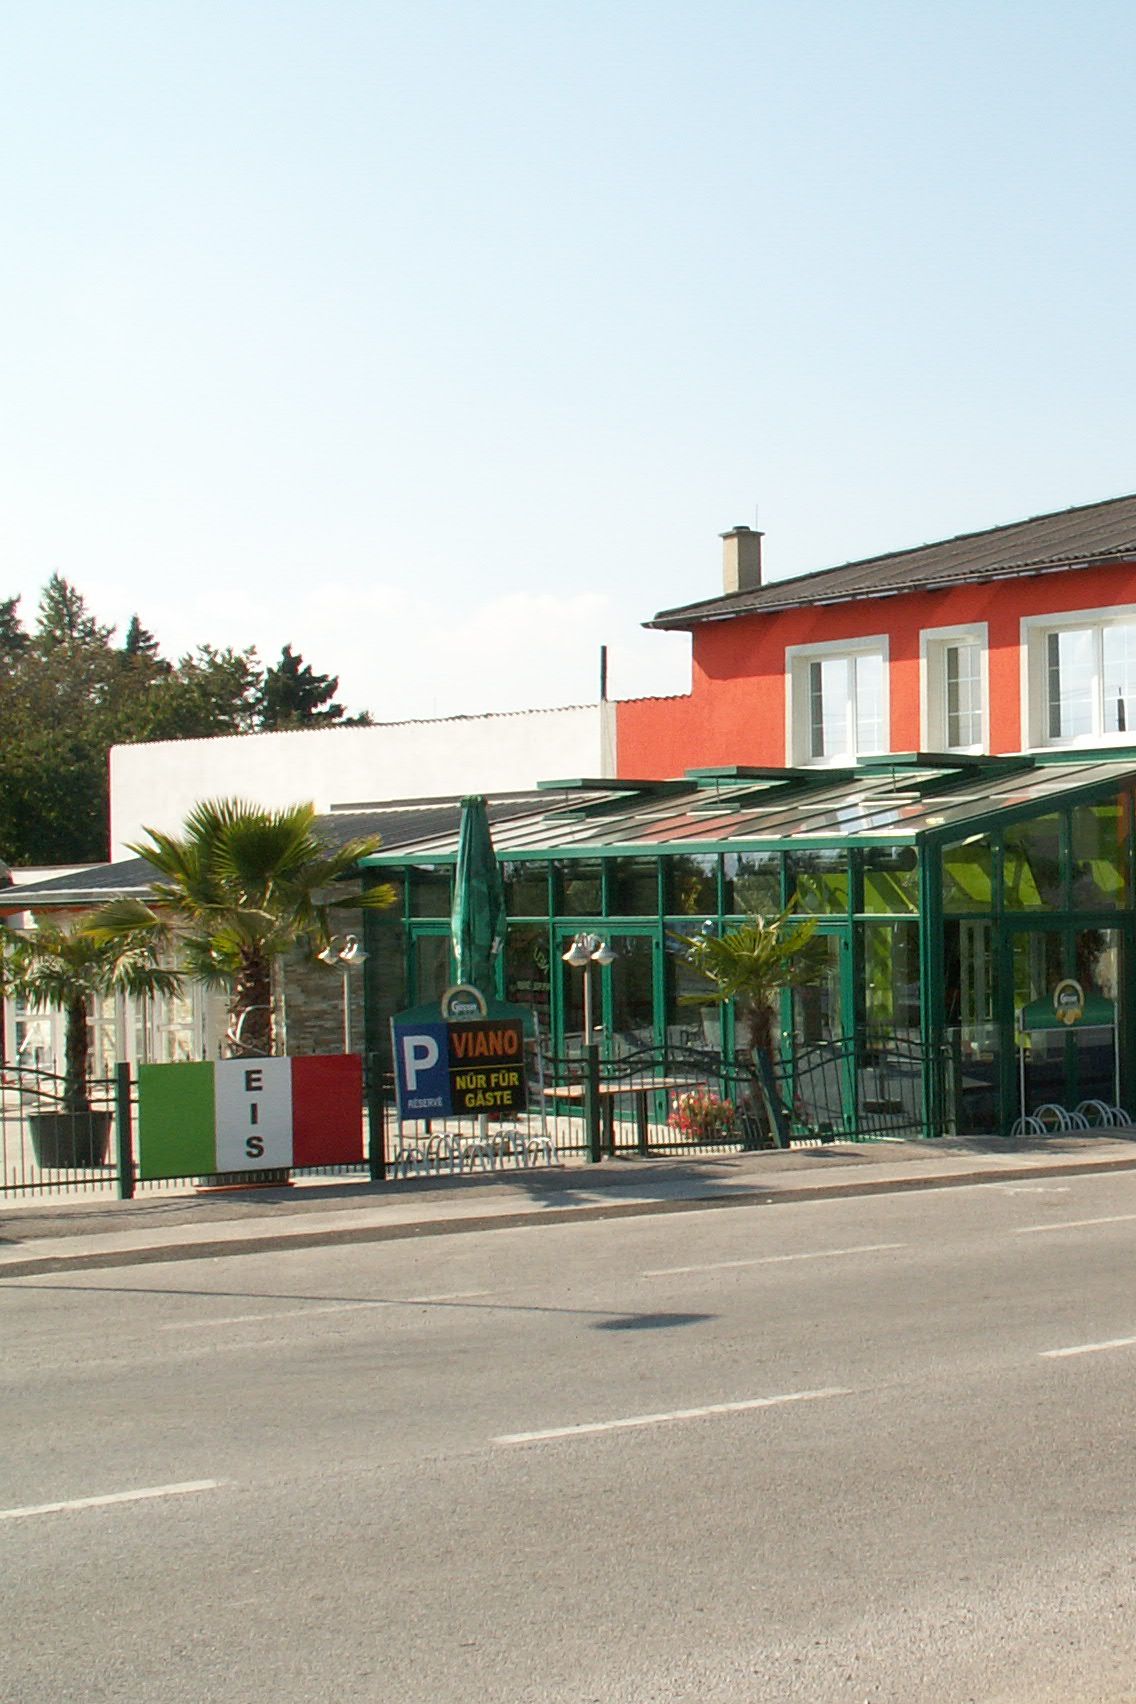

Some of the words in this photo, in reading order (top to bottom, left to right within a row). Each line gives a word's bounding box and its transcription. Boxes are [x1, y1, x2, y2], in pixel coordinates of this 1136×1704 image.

[451, 1029, 518, 1058] VIANO
[403, 1035, 439, 1091] P
[491, 1069, 519, 1088] FÜR
[245, 1069, 264, 1158] EIS
[465, 1090, 512, 1108] GÄSTE
